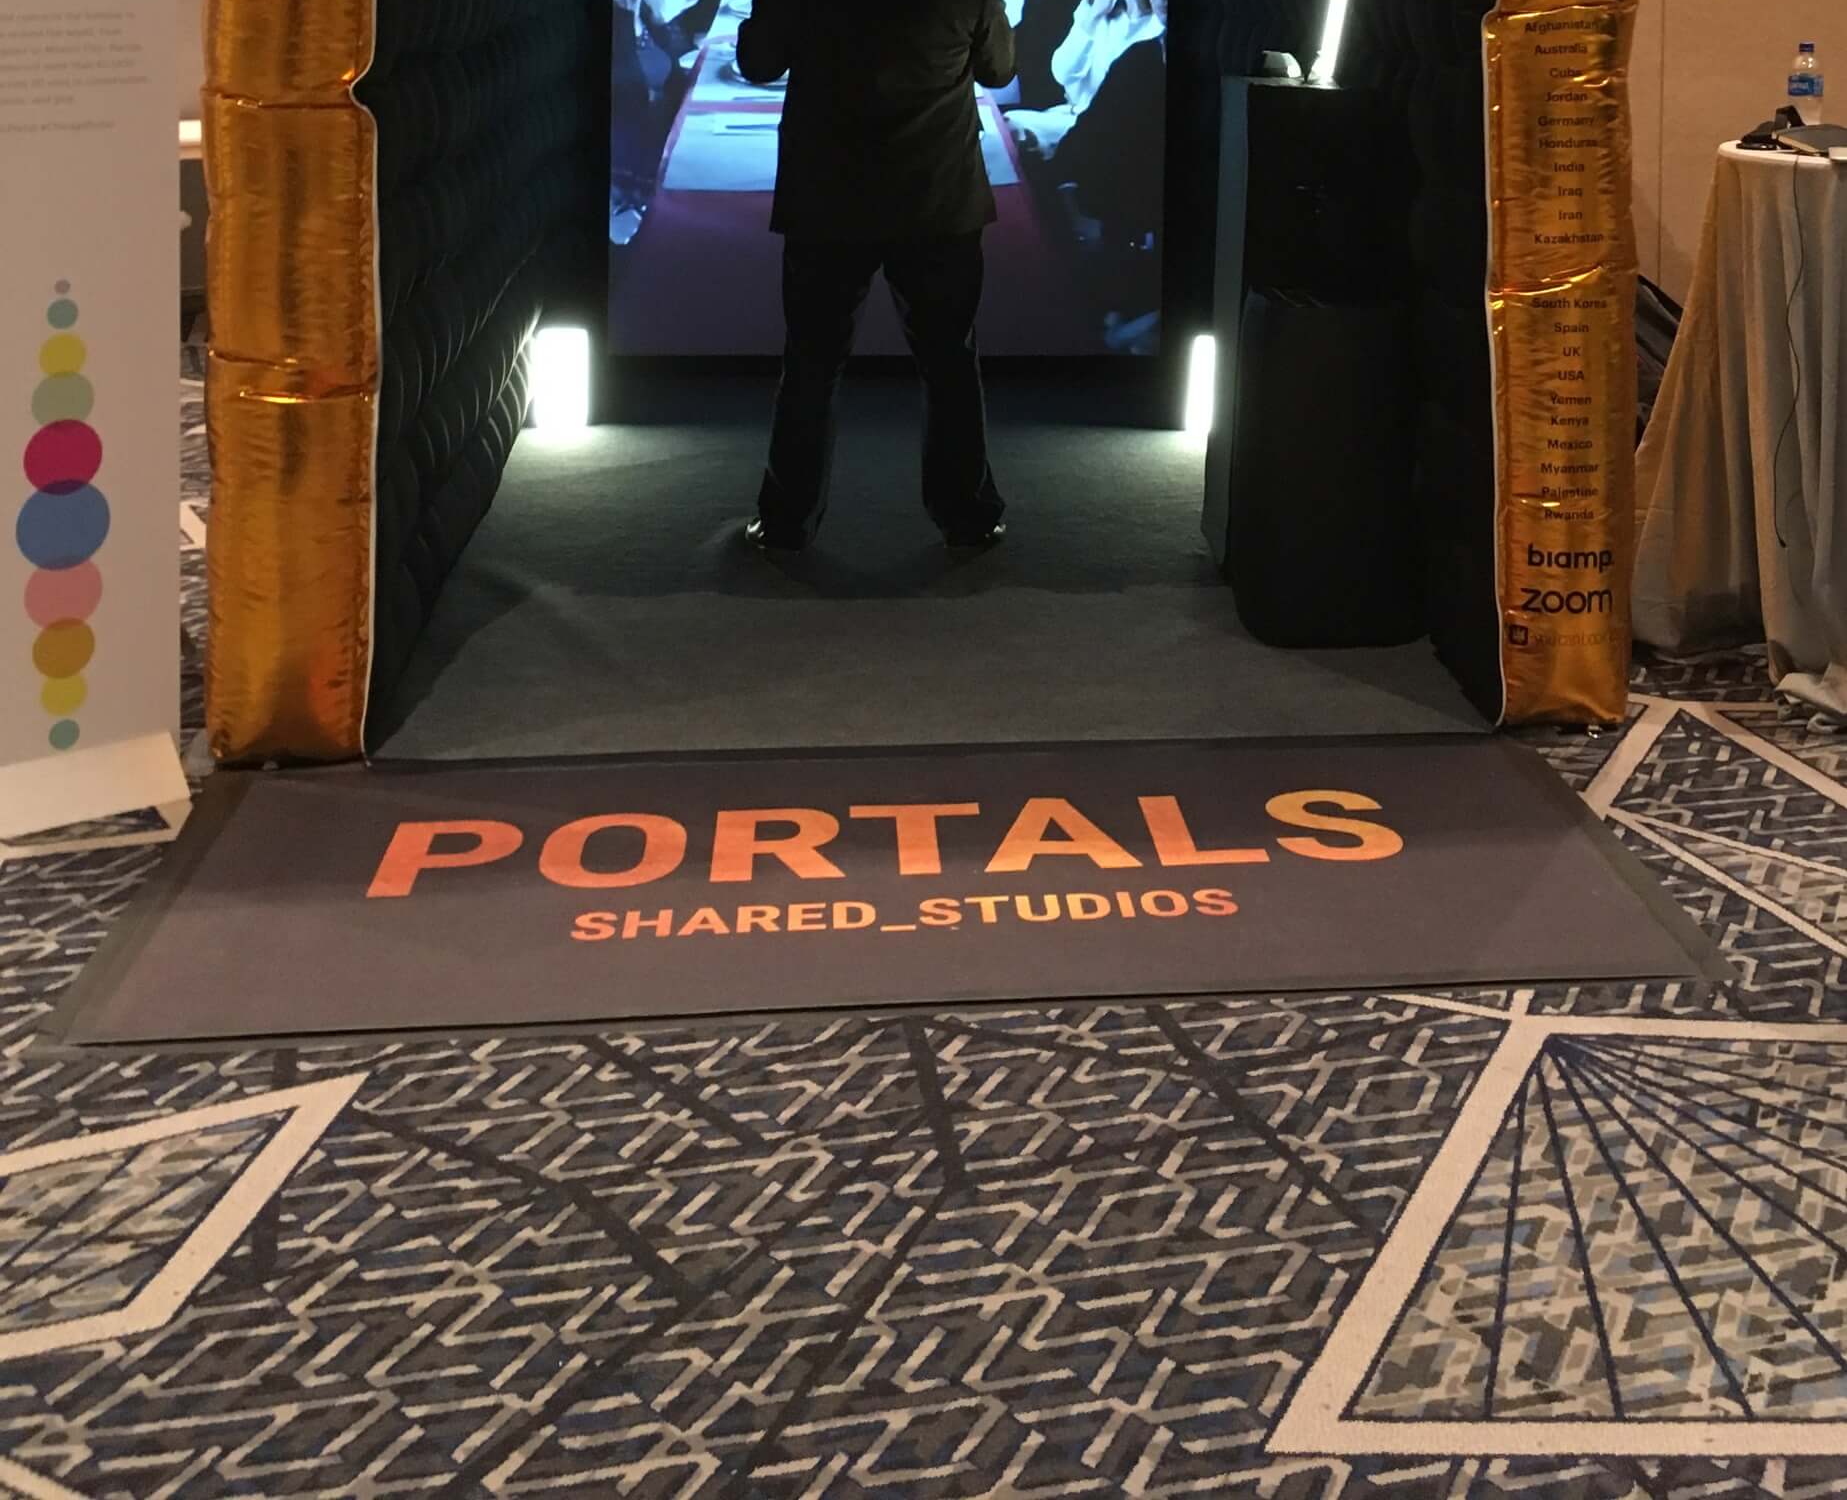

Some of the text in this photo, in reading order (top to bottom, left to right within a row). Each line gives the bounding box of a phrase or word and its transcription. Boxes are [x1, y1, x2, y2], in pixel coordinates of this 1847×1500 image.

[1534, 43, 1588, 55] Australia
[1550, 67, 1583, 78] Cuba
[1545, 91, 1588, 102] Jordan
[1537, 115, 1595, 128] Germany
[1538, 137, 1598, 149] Honduras
[1553, 161, 1585, 173] India
[1558, 186, 1584, 198] Iraq
[1558, 210, 1584, 221] Iran
[1534, 232, 1605, 245] Kazakhstan
[1531, 297, 1608, 309] South Korea
[1554, 321, 1590, 335] Spain
[1562, 346, 1582, 357] UK
[1558, 370, 1585, 381] USA
[1550, 395, 1592, 405] Yemen
[1551, 415, 1590, 427] Kenya
[1547, 439, 1593, 451] Mexico
[1540, 463, 1599, 476] Myanmar
[1541, 486, 1599, 499] Palestine
[1544, 508, 1594, 520] Rwanda
[1520, 587, 1613, 614] zoom
[366, 789, 1405, 898] PORTALS
[570, 888, 1240, 942] SHARED_STUDIOS
